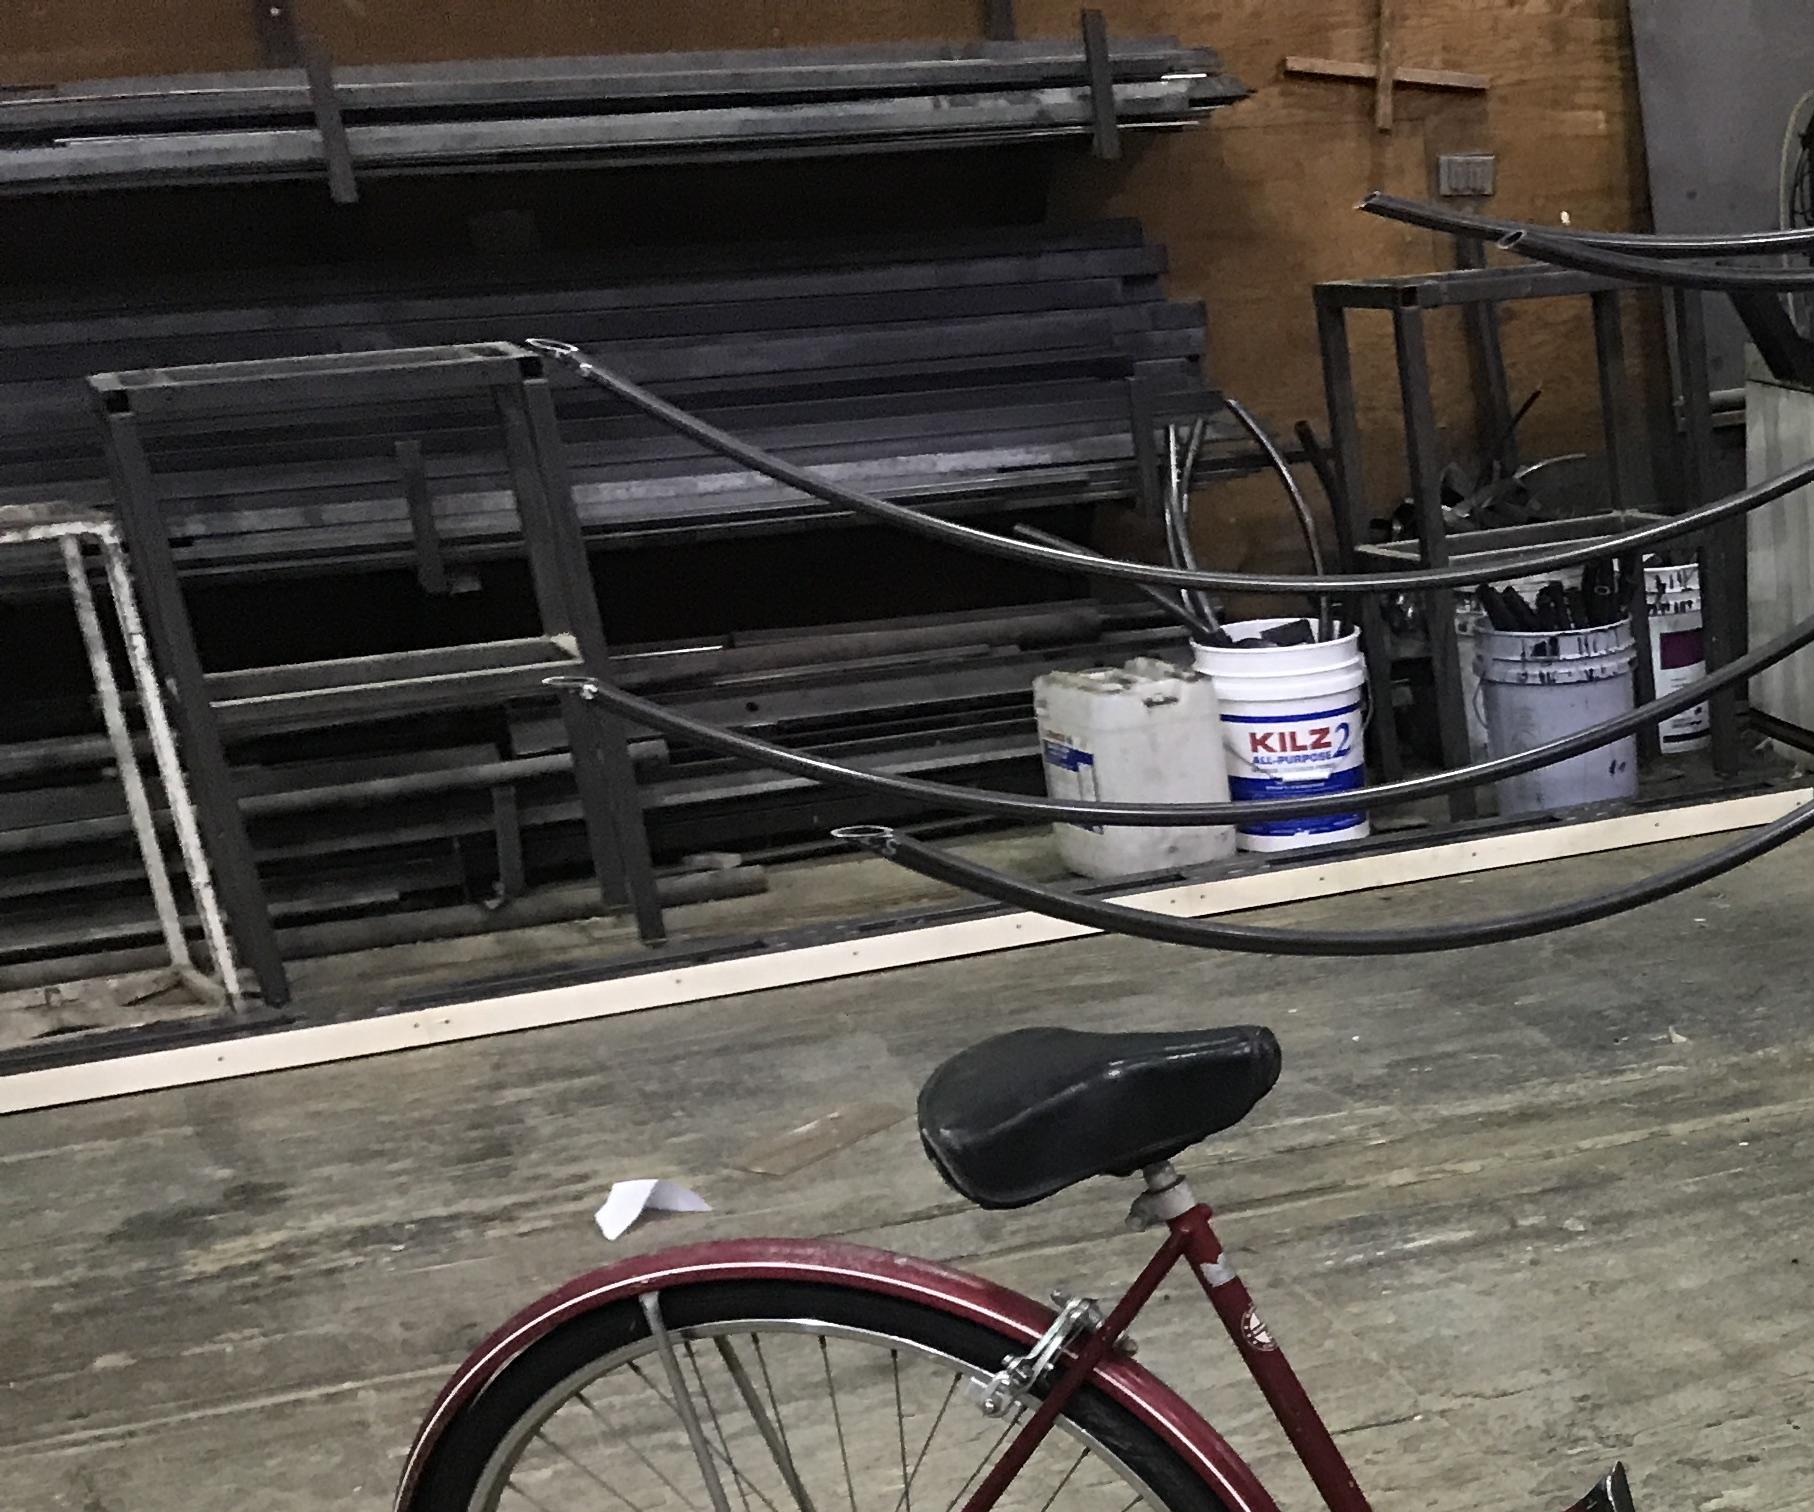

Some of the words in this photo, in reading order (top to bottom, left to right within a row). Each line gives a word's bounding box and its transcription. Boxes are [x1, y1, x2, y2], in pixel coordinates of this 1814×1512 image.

[1249, 727, 1332, 753] KILZ
[1333, 722, 1352, 758] 2
[1252, 750, 1332, 765] ALL-PURPOSE
